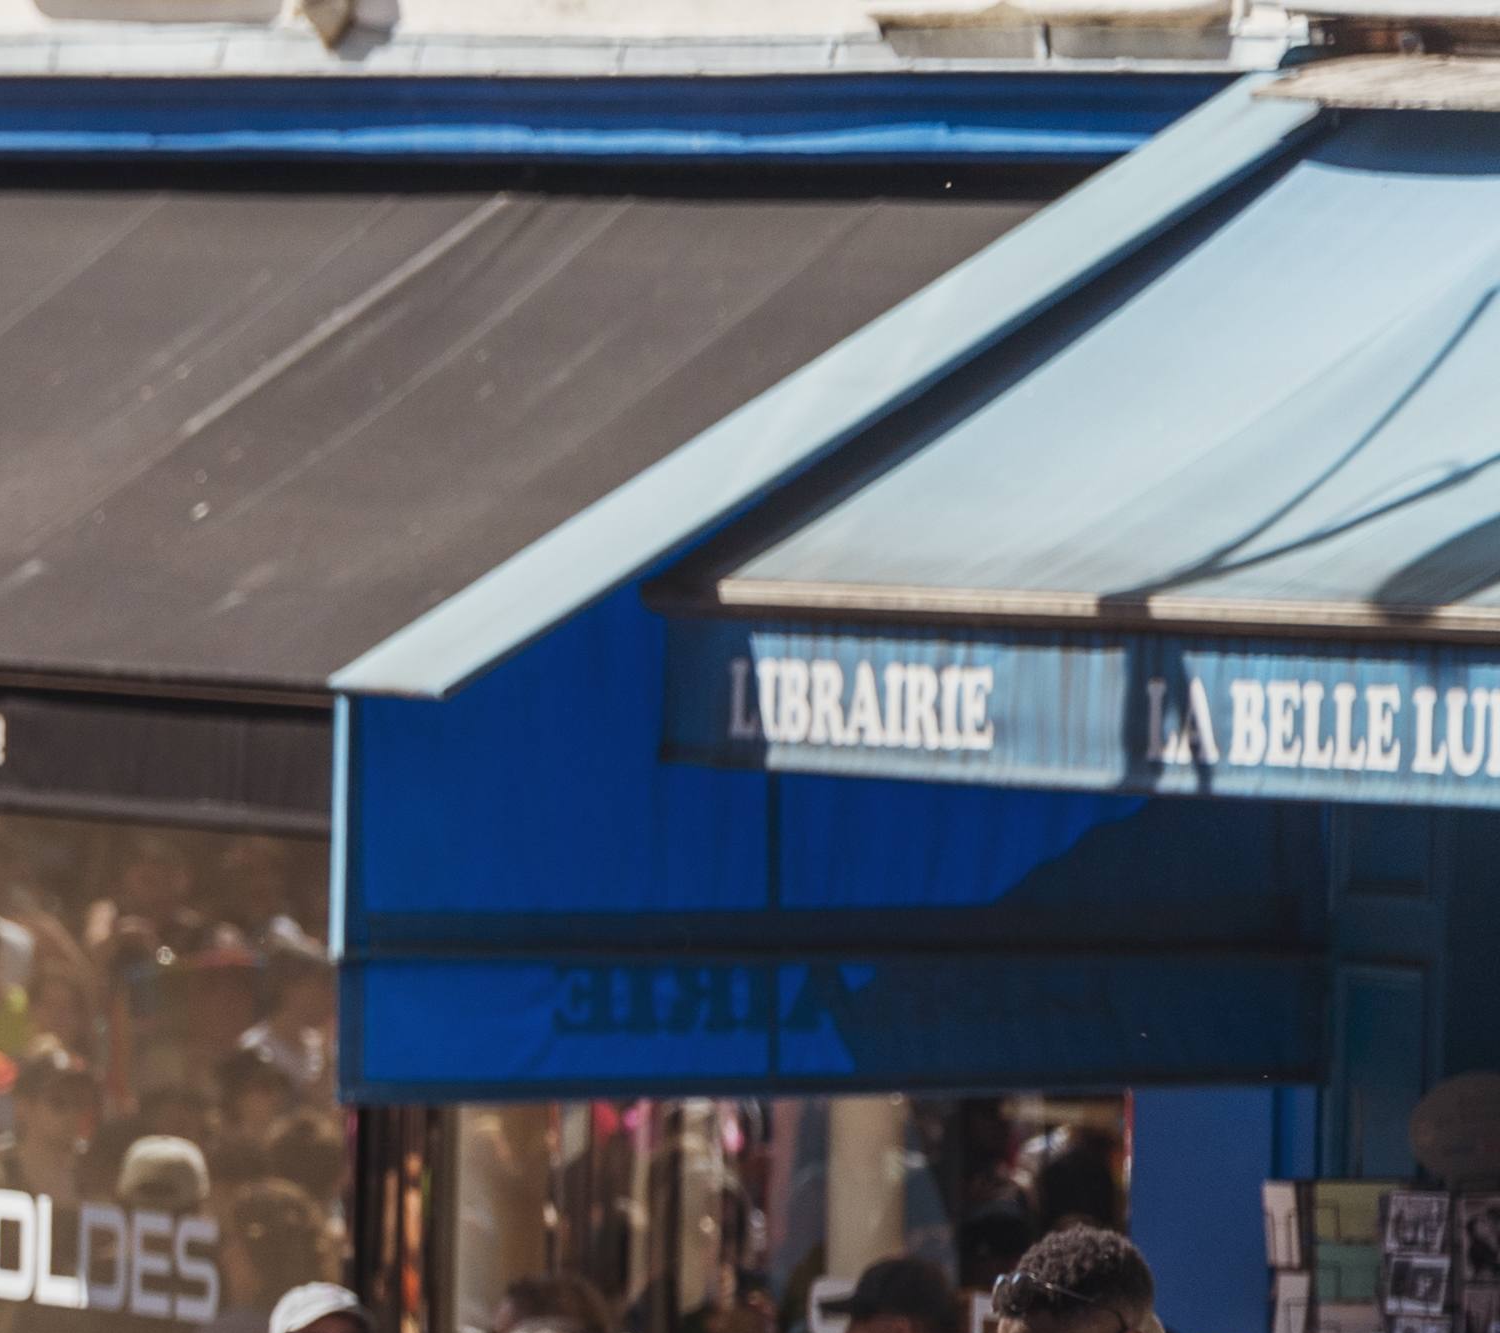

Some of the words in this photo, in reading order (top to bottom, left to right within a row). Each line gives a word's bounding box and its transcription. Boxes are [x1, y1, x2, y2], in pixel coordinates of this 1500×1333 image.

[729, 656, 997, 752] LIBRAIRIE
[1146, 675, 1219, 765] LA
[1228, 679, 1401, 772] BELLE
